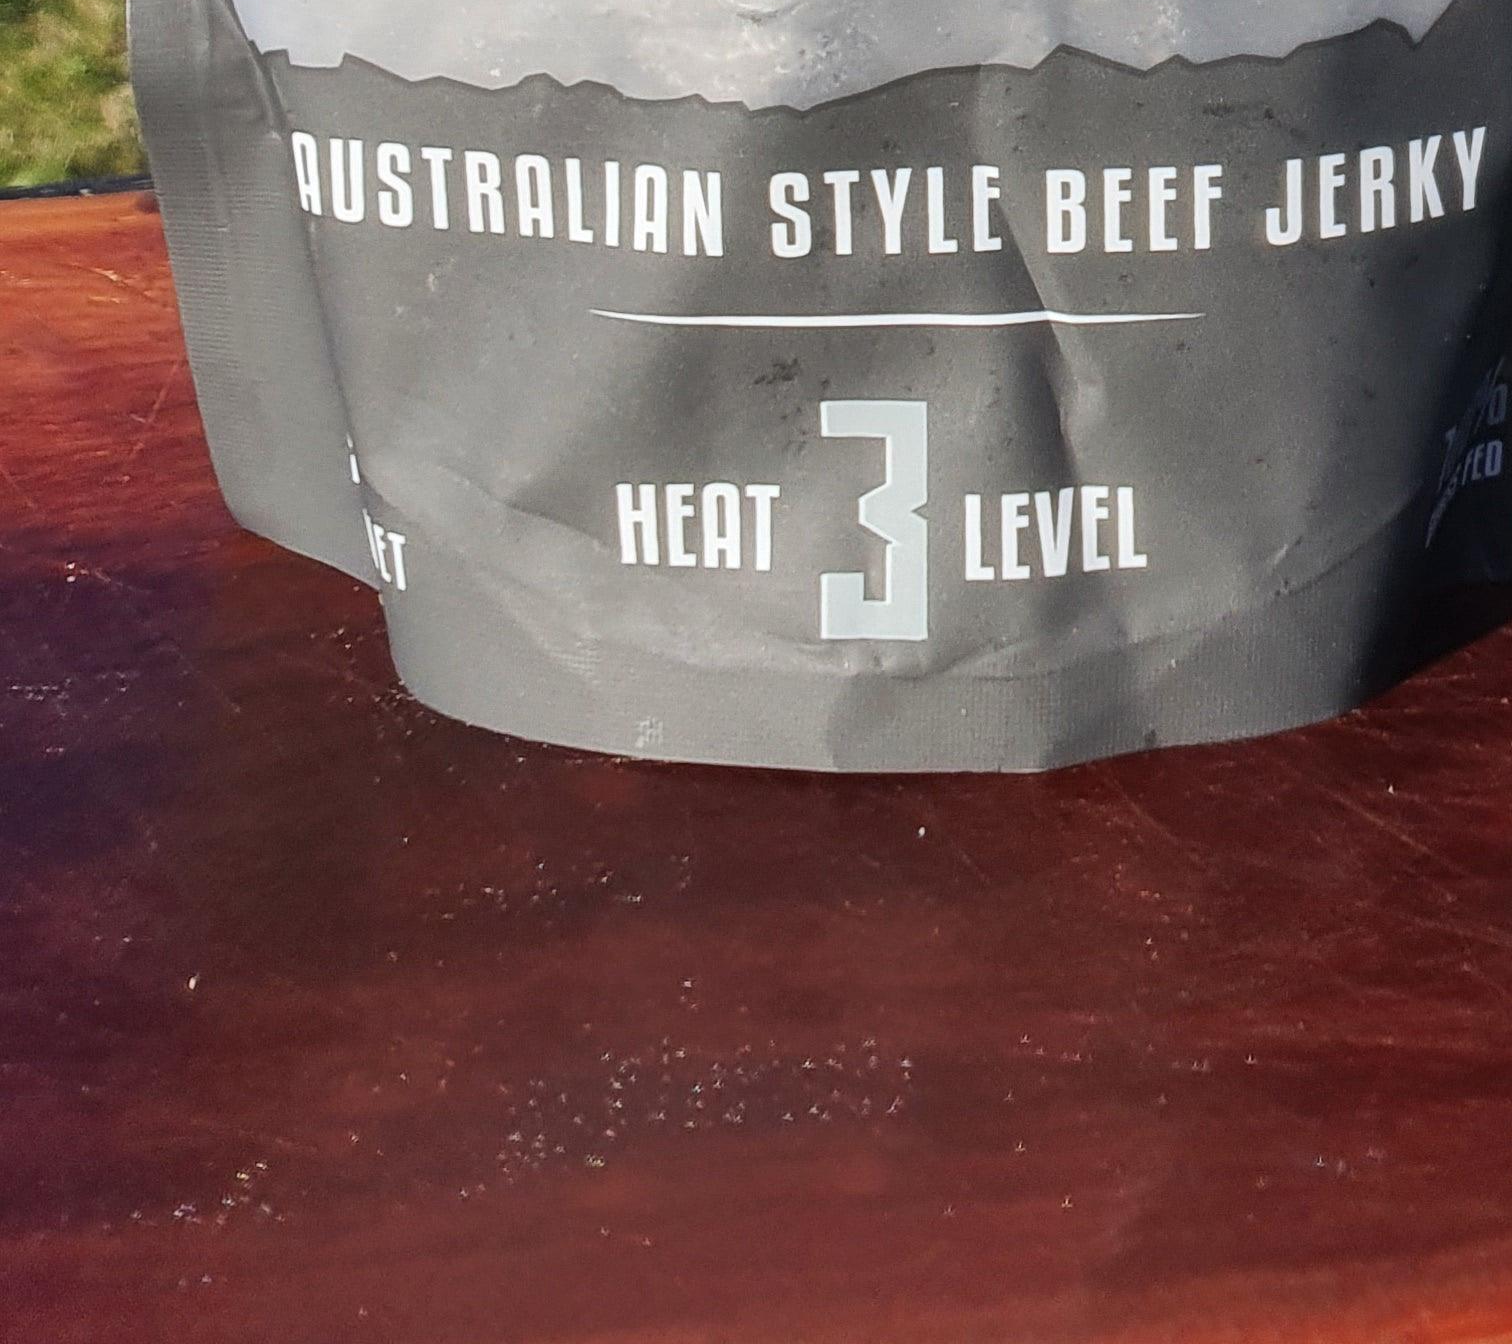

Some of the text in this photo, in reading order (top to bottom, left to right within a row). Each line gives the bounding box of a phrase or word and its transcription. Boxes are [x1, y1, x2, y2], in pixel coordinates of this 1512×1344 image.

[291, 125, 1488, 259] AUSTRALIAN STYLE BEEF JERKY
[617, 398, 1148, 642] HEAT 3 LEVEL
